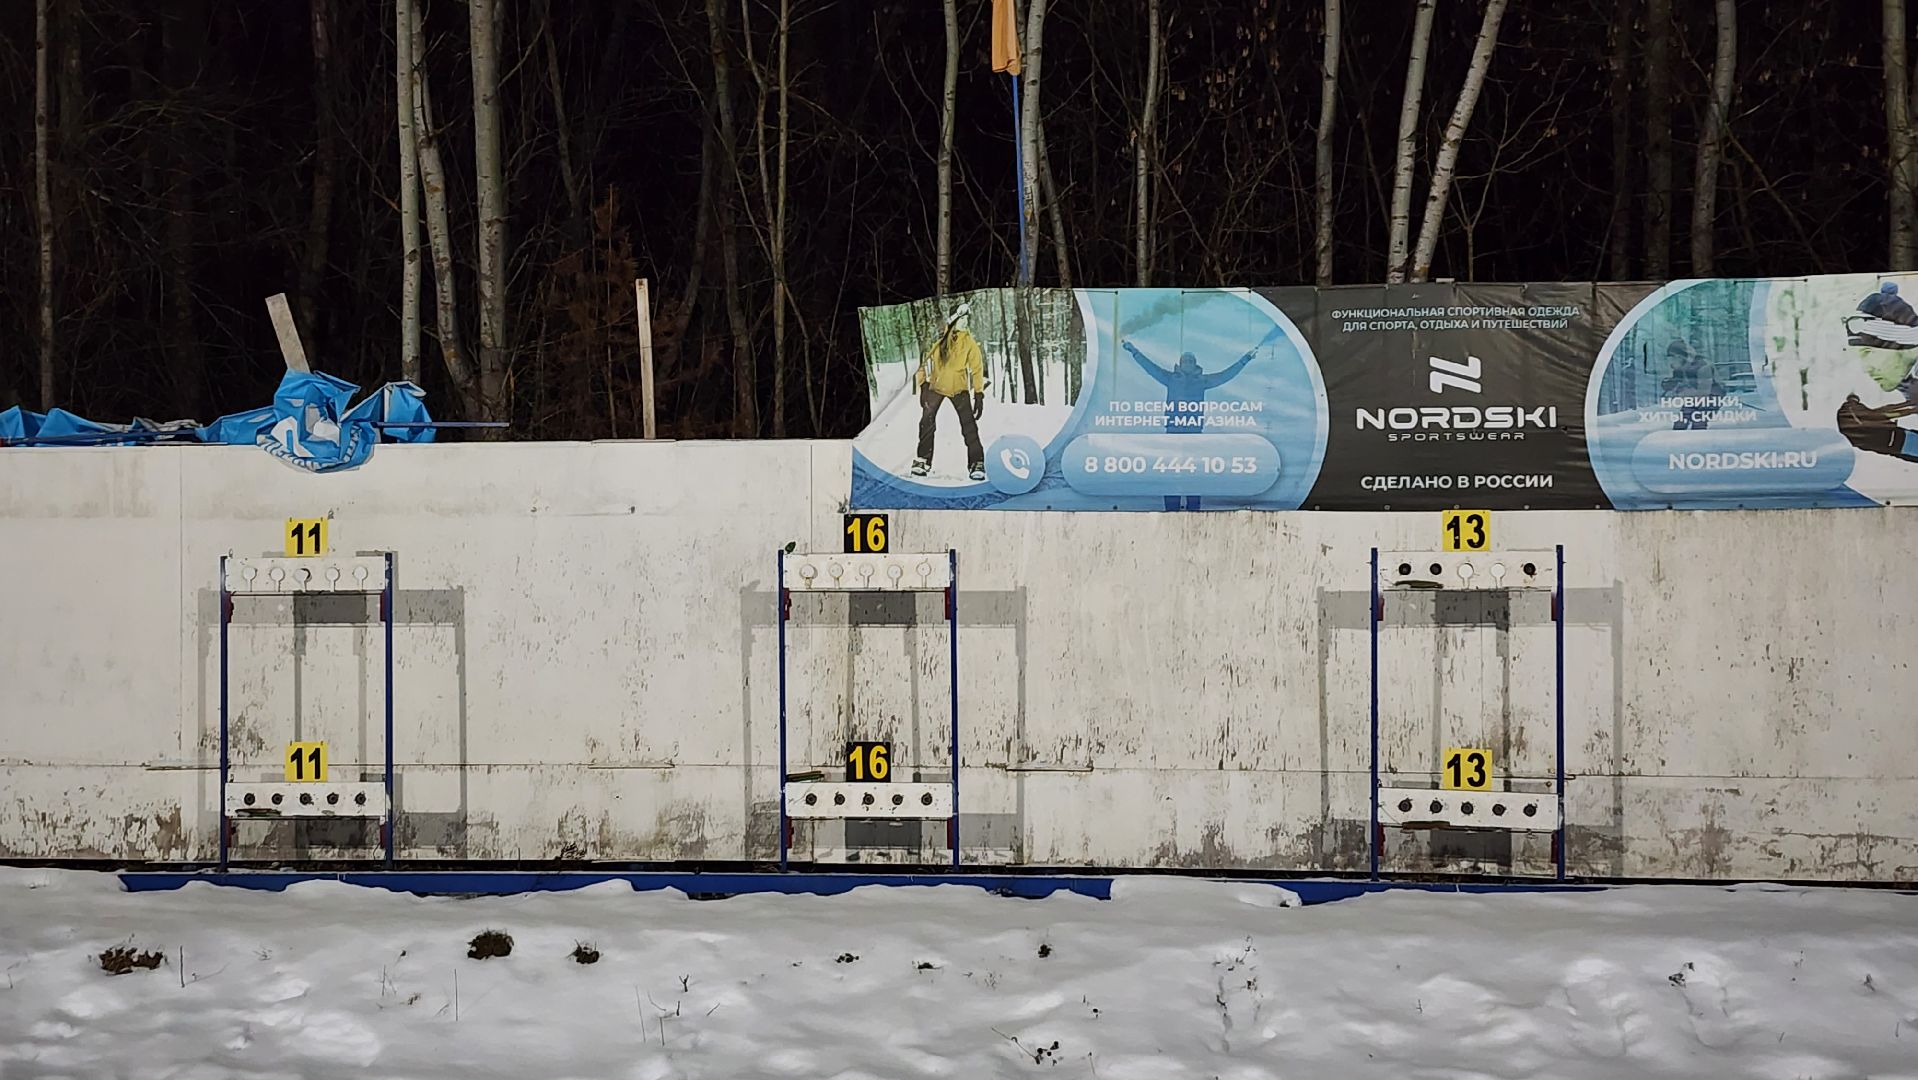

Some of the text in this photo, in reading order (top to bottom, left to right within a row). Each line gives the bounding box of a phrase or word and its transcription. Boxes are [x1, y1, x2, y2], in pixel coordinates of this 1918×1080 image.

[1331, 306, 1580, 319] ФУНКЦИОНАЛЬНАЯ СПОРТИВНАЯ ОДЕЖДА
[1343, 318, 1568, 333] ДЛЯ СПОРТА, ОТДЫХА И ПУТЕШЕСТВИЙ
[1109, 401, 1263, 412] ПО ВСЕМ ВОПРОСАМ
[1660, 395, 1743, 409] НОВИНКИ,
[1095, 415, 1257, 427] ИНТЕРНЕТ-МАГАЗИНА
[1356, 406, 1557, 430] NORDSKI
[1638, 410, 1757, 424] ХИТЫ, СКИДКИ
[1388, 432, 1525, 442] SPORTSWEAR
[1084, 456, 1257, 473] 8 800 444 10 53
[1668, 450, 1818, 470] NORDSKI.RU
[1361, 474, 1553, 491] СДЕЛАНО В РОССИИ
[291, 522, 321, 555] 11
[847, 516, 886, 552] 16
[1446, 514, 1486, 549] 13
[290, 747, 322, 780] 11
[849, 744, 888, 779] 16
[1446, 752, 1486, 788] 13
